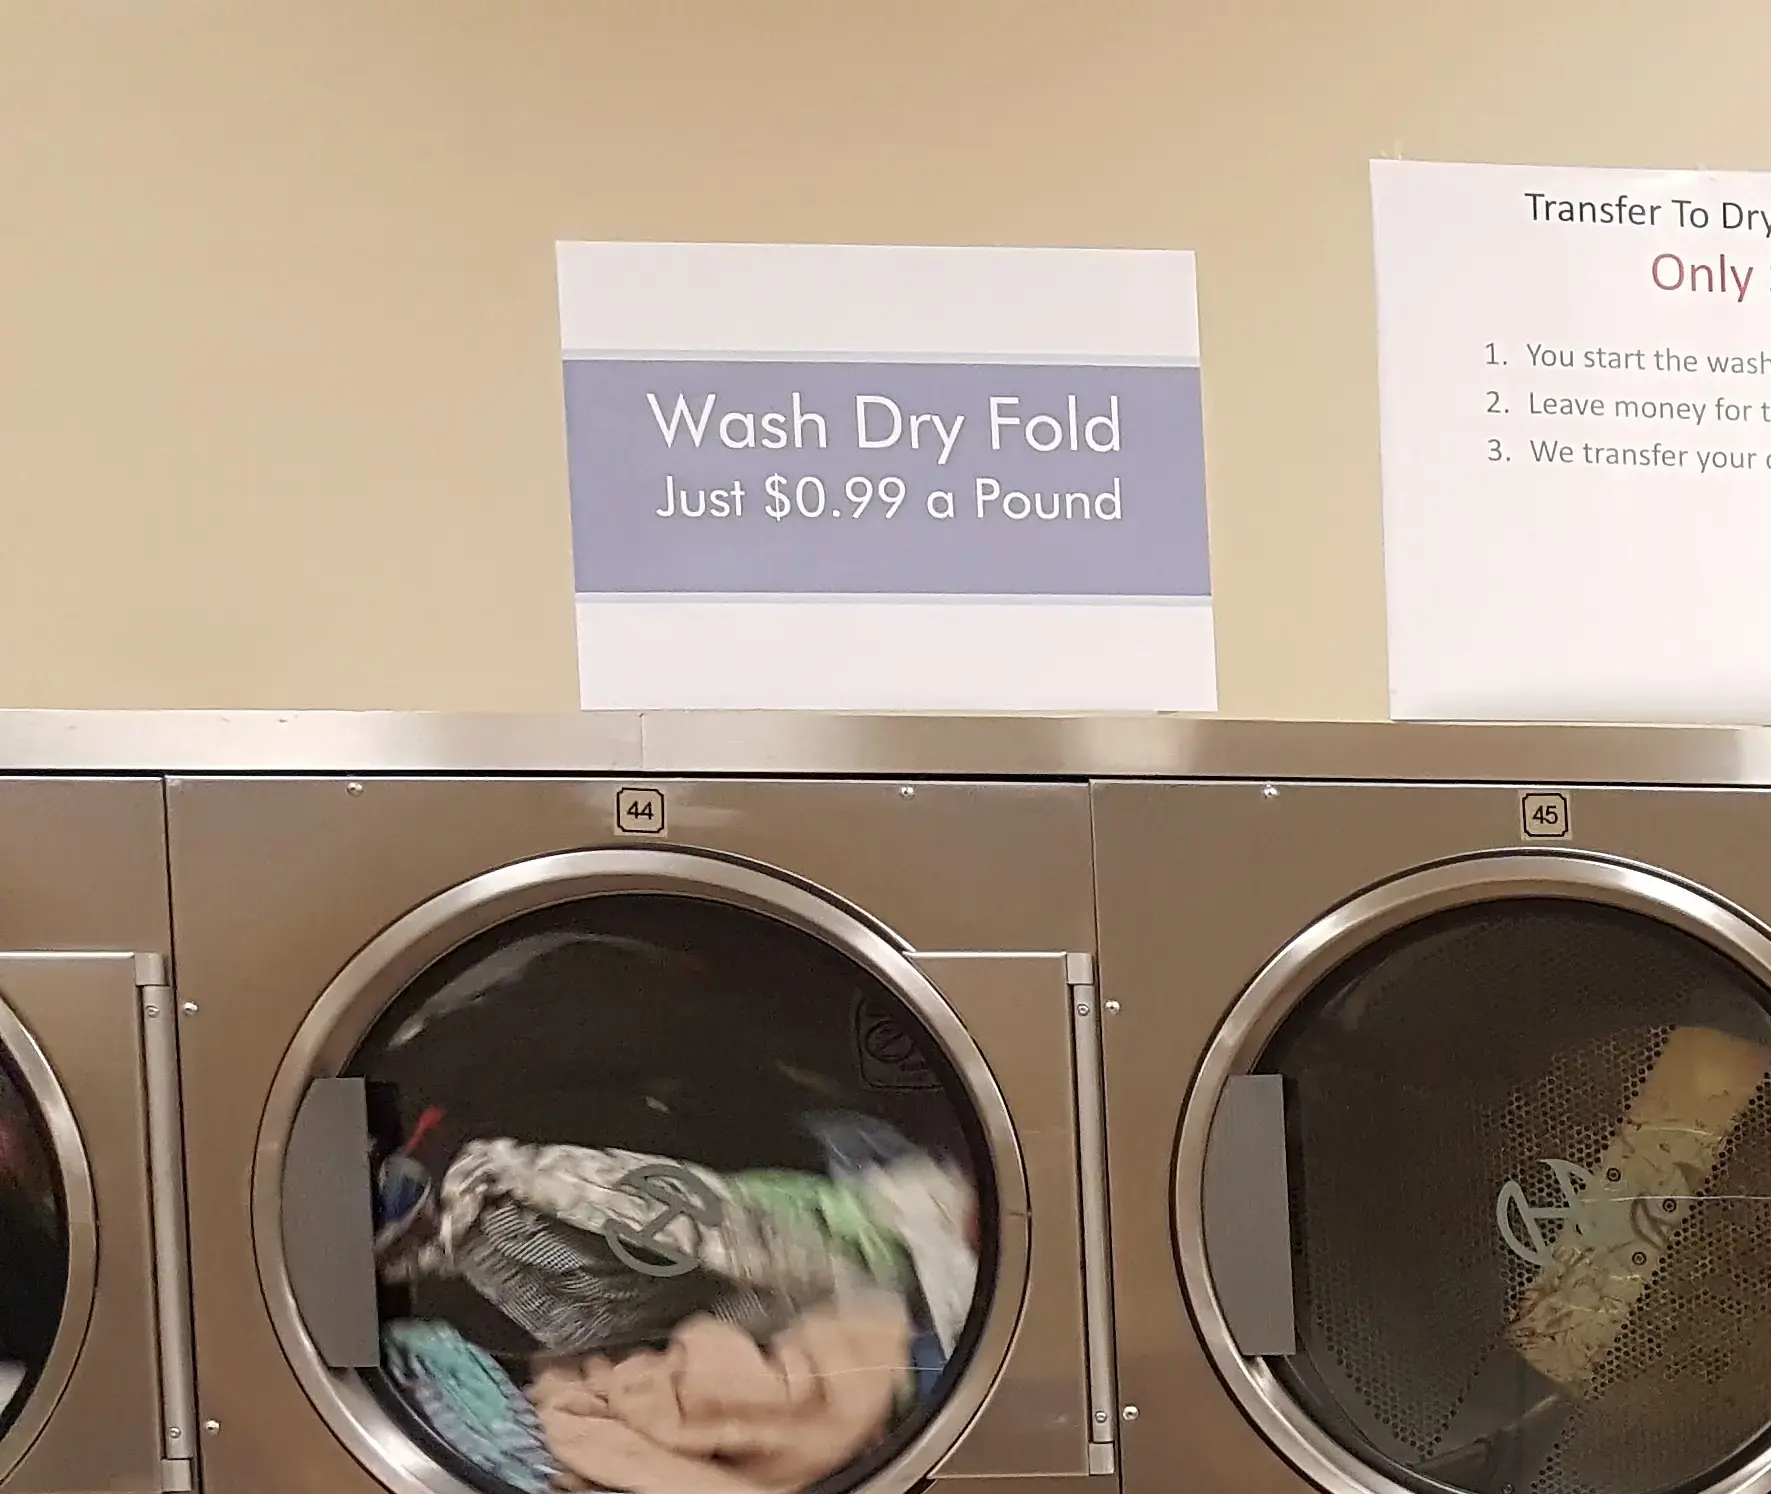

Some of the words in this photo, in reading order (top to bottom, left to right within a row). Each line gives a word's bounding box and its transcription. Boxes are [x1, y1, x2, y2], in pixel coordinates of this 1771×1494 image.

[1524, 193, 1661, 225] Transfer
[1672, 200, 1708, 228] To
[1652, 254, 1753, 302] Only
[1486, 343, 1507, 365] 1.
[1527, 344, 1573, 367] You
[1584, 348, 1645, 370] start
[1654, 348, 1697, 372] the
[1487, 391, 1509, 413] 2.
[1530, 392, 1604, 416] Leave
[1615, 401, 1706, 425] money
[1715, 397, 1752, 421] for
[646, 393, 826, 448] Wash
[857, 396, 964, 464] Dry
[990, 395, 1119, 452] Fold
[656, 476, 745, 516] Just
[765, 473, 905, 521] $0.99
[927, 491, 954, 518] a
[977, 478, 1121, 520] Pound
[627, 800, 654, 820] 44
[1532, 805, 1558, 825] 45
